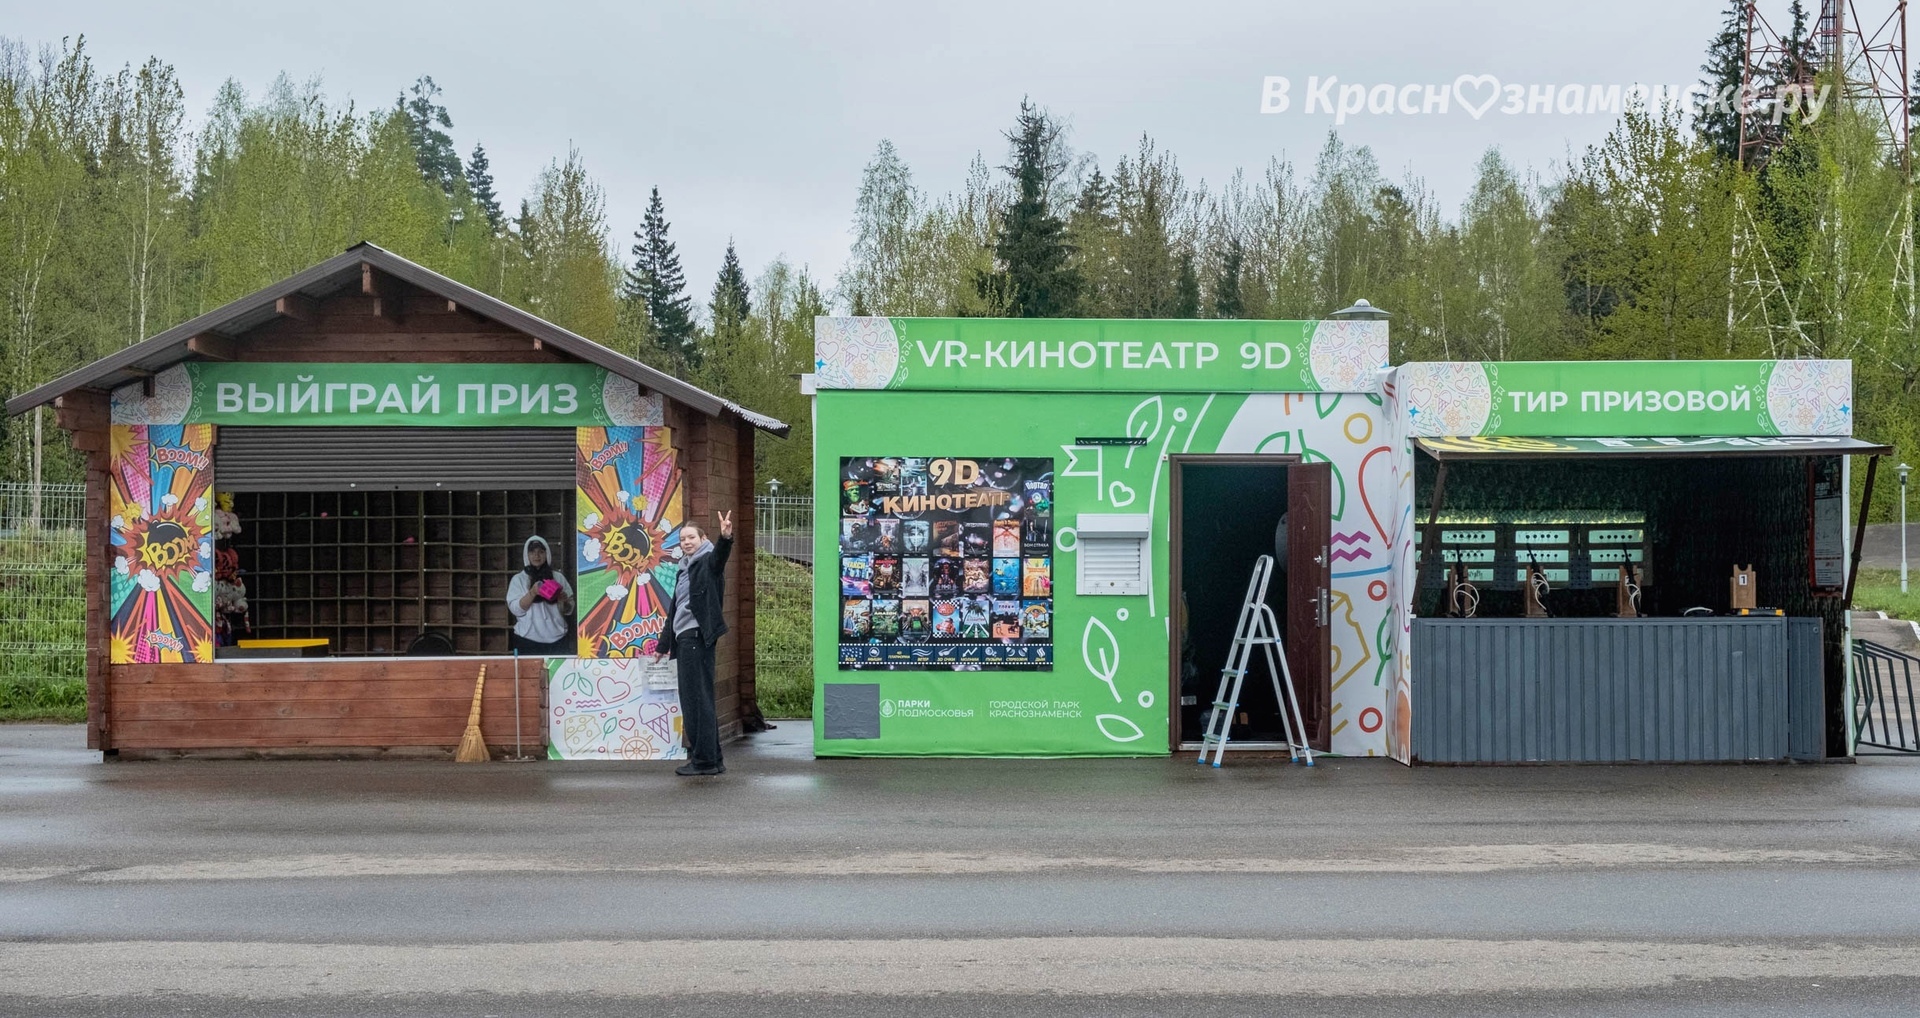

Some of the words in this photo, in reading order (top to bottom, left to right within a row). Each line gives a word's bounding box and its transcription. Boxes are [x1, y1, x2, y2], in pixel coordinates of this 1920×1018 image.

[916, 340, 1219, 369] VR-КИНОТЕАТР
[1239, 341, 1292, 370] 9D
[216, 374, 440, 415] ВЫЙГРАЙ
[456, 383, 578, 414] ПРИЗ
[1507, 390, 1568, 413] ТИР
[1580, 384, 1751, 412] ПРИЗОВОЙ
[929, 459, 980, 486] 9D
[883, 492, 1010, 514] КИНОТЕАТР
[147, 535, 199, 570] BOOM
[604, 532, 649, 572] BOOM
[897, 700, 931, 708] ПАРКИ
[897, 709, 974, 718] ПОДМОСКОВЬЯ
[989, 699, 1049, 710] ГОРОДСКОЙ
[1053, 701, 1080, 709] ПАРК
[989, 709, 1082, 718] КРАСНОЗНАМЕНСК
